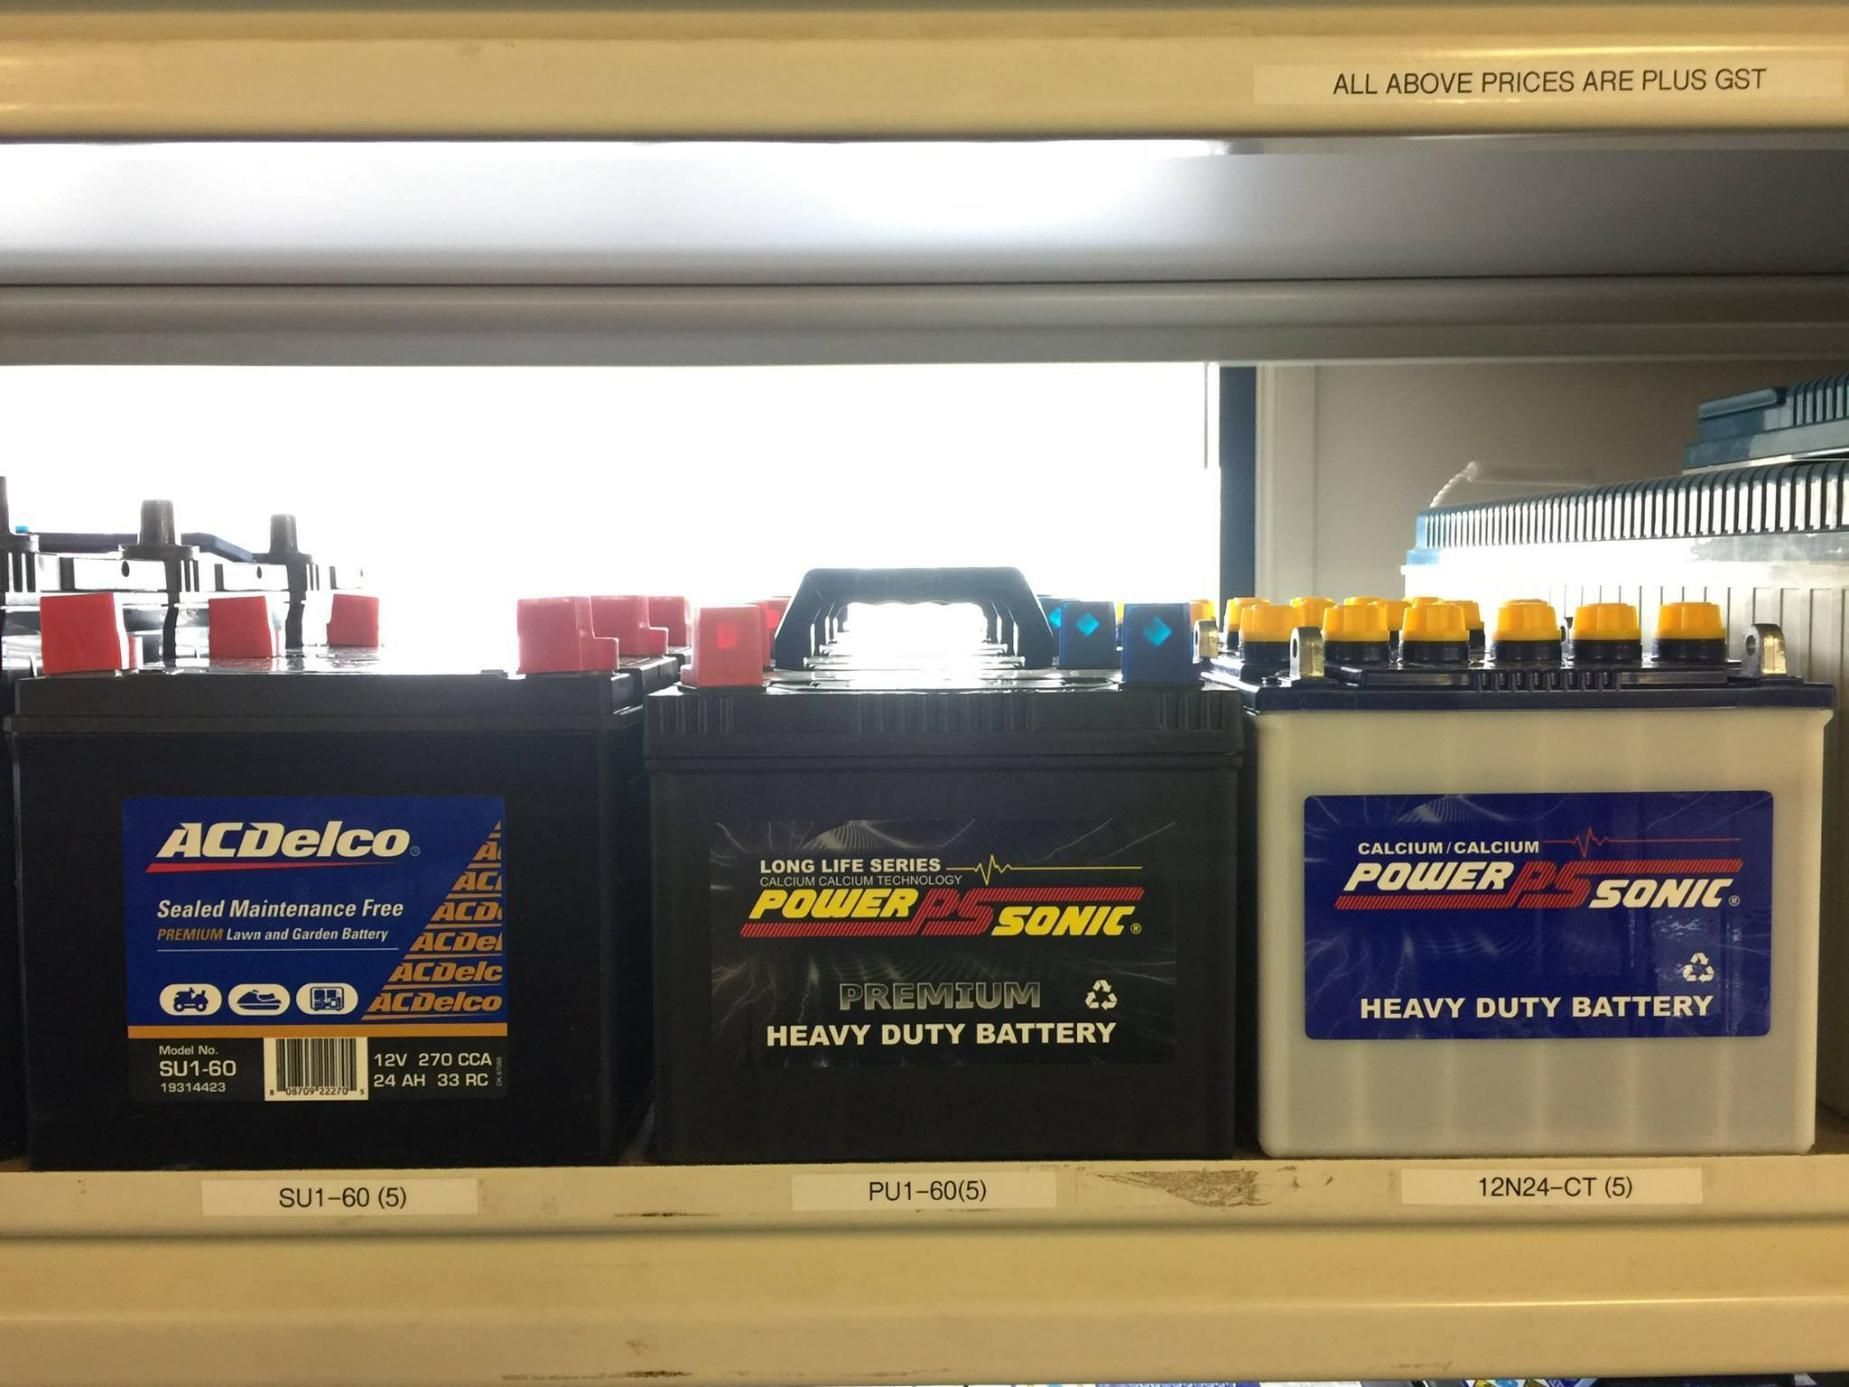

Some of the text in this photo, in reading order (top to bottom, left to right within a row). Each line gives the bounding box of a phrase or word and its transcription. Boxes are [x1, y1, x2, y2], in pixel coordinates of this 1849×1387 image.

[1332, 68, 1768, 95] ALL ABOVE PRICES ARE PLUS GST
[155, 820, 411, 858] ACDelco
[473, 841, 502, 861] A
[760, 858, 941, 873] LONG LIFE SERIES
[452, 871, 502, 891] AC
[760, 875, 962, 887] CALCIUM CALCIUM TECHNOLOGY
[1343, 860, 1733, 909] POWER PS SONIC
[157, 898, 404, 919] Sealed Maintenance Free
[431, 902, 502, 921] ACD
[749, 887, 1135, 936] POWER PS SONIC
[157, 926, 389, 943] PREMIUM Lawn and Garden Battery
[367, 992, 503, 1012] ACDelco
[839, 982, 1041, 1010] PREMIUM
[1361, 996, 1714, 1018] HEAVY DUTY BATTERY
[767, 1022, 1117, 1046] HEAVY DUTY BATTERY
[159, 1045, 218, 1056] Model No.
[375, 1054, 407, 1067] 12V
[418, 1053, 453, 1066] 270
[458, 1053, 492, 1066] CCA
[159, 1060, 237, 1077] SU1-60
[160, 1082, 226, 1093] 19314423
[374, 1073, 489, 1088] 24 AH 33 RC
[319, 1087, 349, 1096] 22270
[869, 1179, 987, 1204] PU1-60(5)
[1478, 1176, 1634, 1199] 12N24-CT (5)
[278, 1187, 407, 1209] SU1-60 (5)
